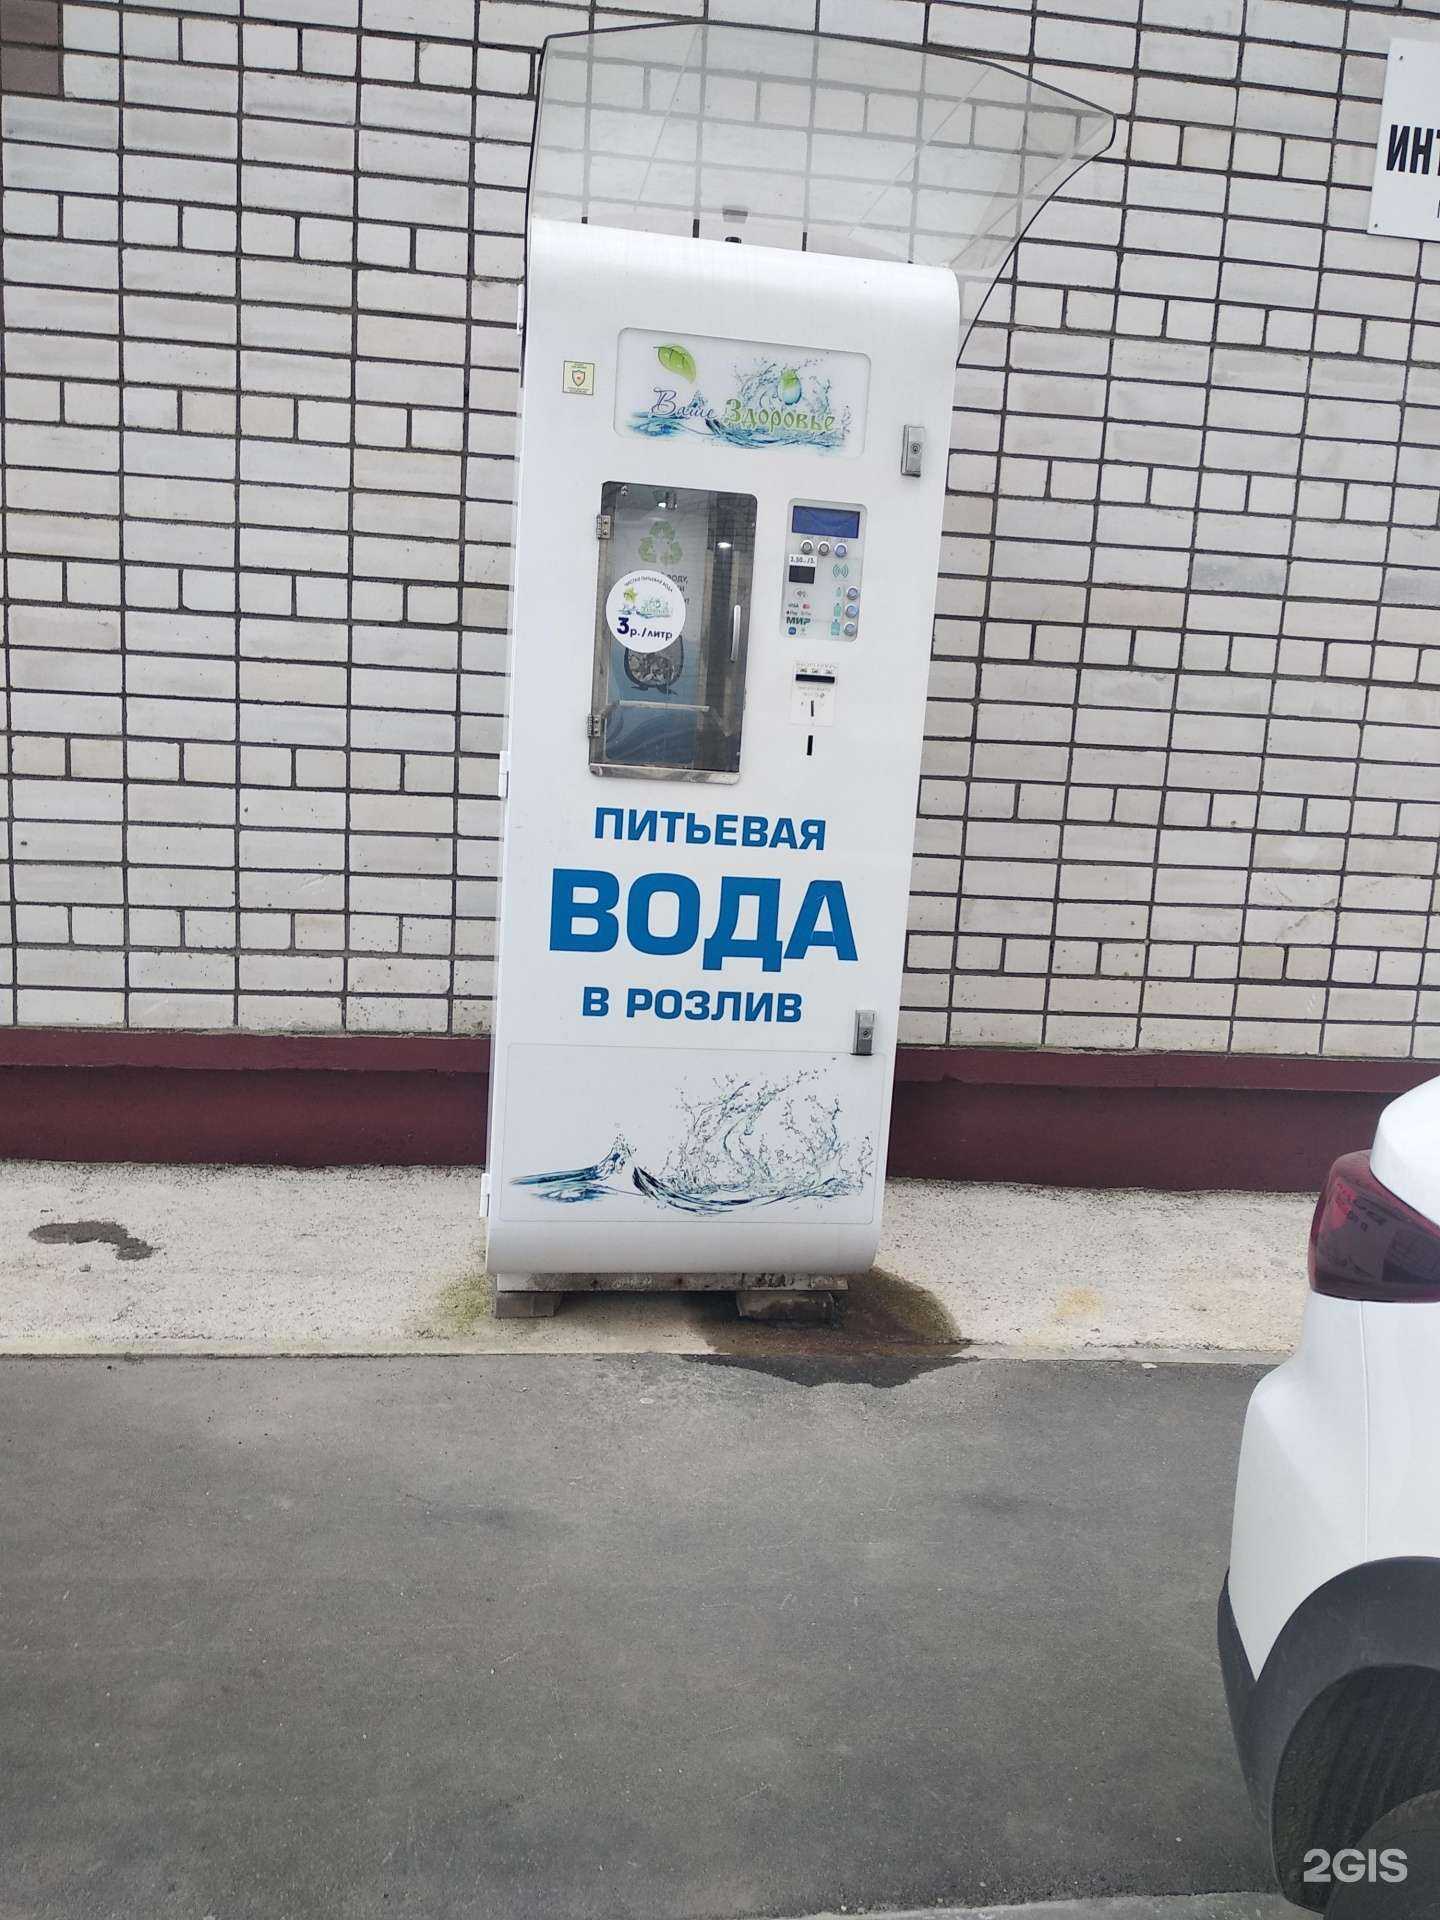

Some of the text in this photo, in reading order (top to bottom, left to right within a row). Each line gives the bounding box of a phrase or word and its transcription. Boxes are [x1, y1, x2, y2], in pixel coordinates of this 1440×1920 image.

[1386, 124, 1440, 176] ИН
[651, 387, 835, 432] Ваше Здоровье
[786, 616, 811, 625] МИР
[594, 807, 826, 850] ПИТЬЕВАЯ
[549, 868, 859, 973] ВОДА
[582, 986, 802, 1023] В РОЗЛИВ
